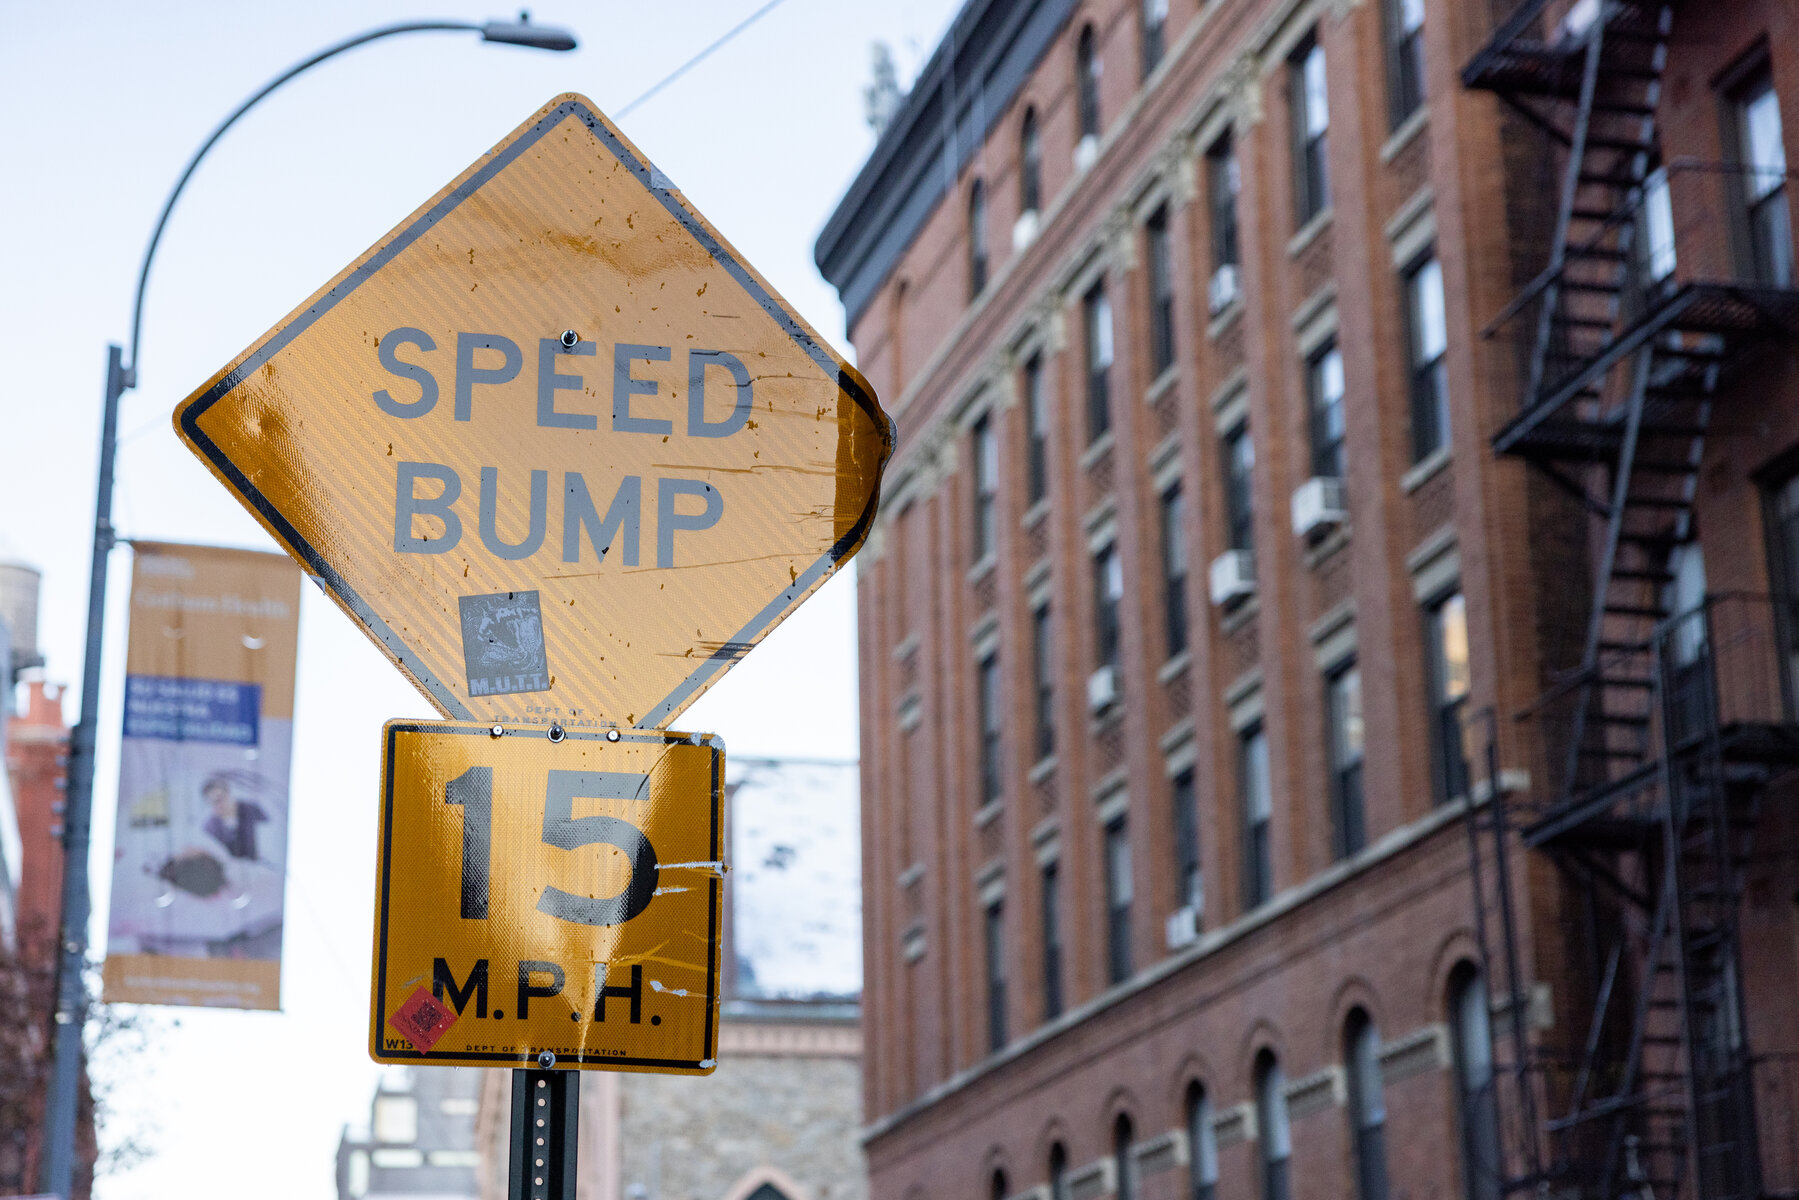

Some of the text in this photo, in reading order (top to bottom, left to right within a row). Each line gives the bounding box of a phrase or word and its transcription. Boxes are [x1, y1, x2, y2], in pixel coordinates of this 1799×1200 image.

[372, 326, 754, 438] SPEED
[394, 461, 724, 569] BUMP
[470, 673, 548, 695] M.U.T.T.
[494, 715, 617, 728] TRANSPORTATION
[526, 705, 585, 716] DEPT OF
[445, 766, 660, 927] 15
[432, 957, 662, 1026] M.P.H.
[523, 1046, 627, 1056] TRANSPORTATION
